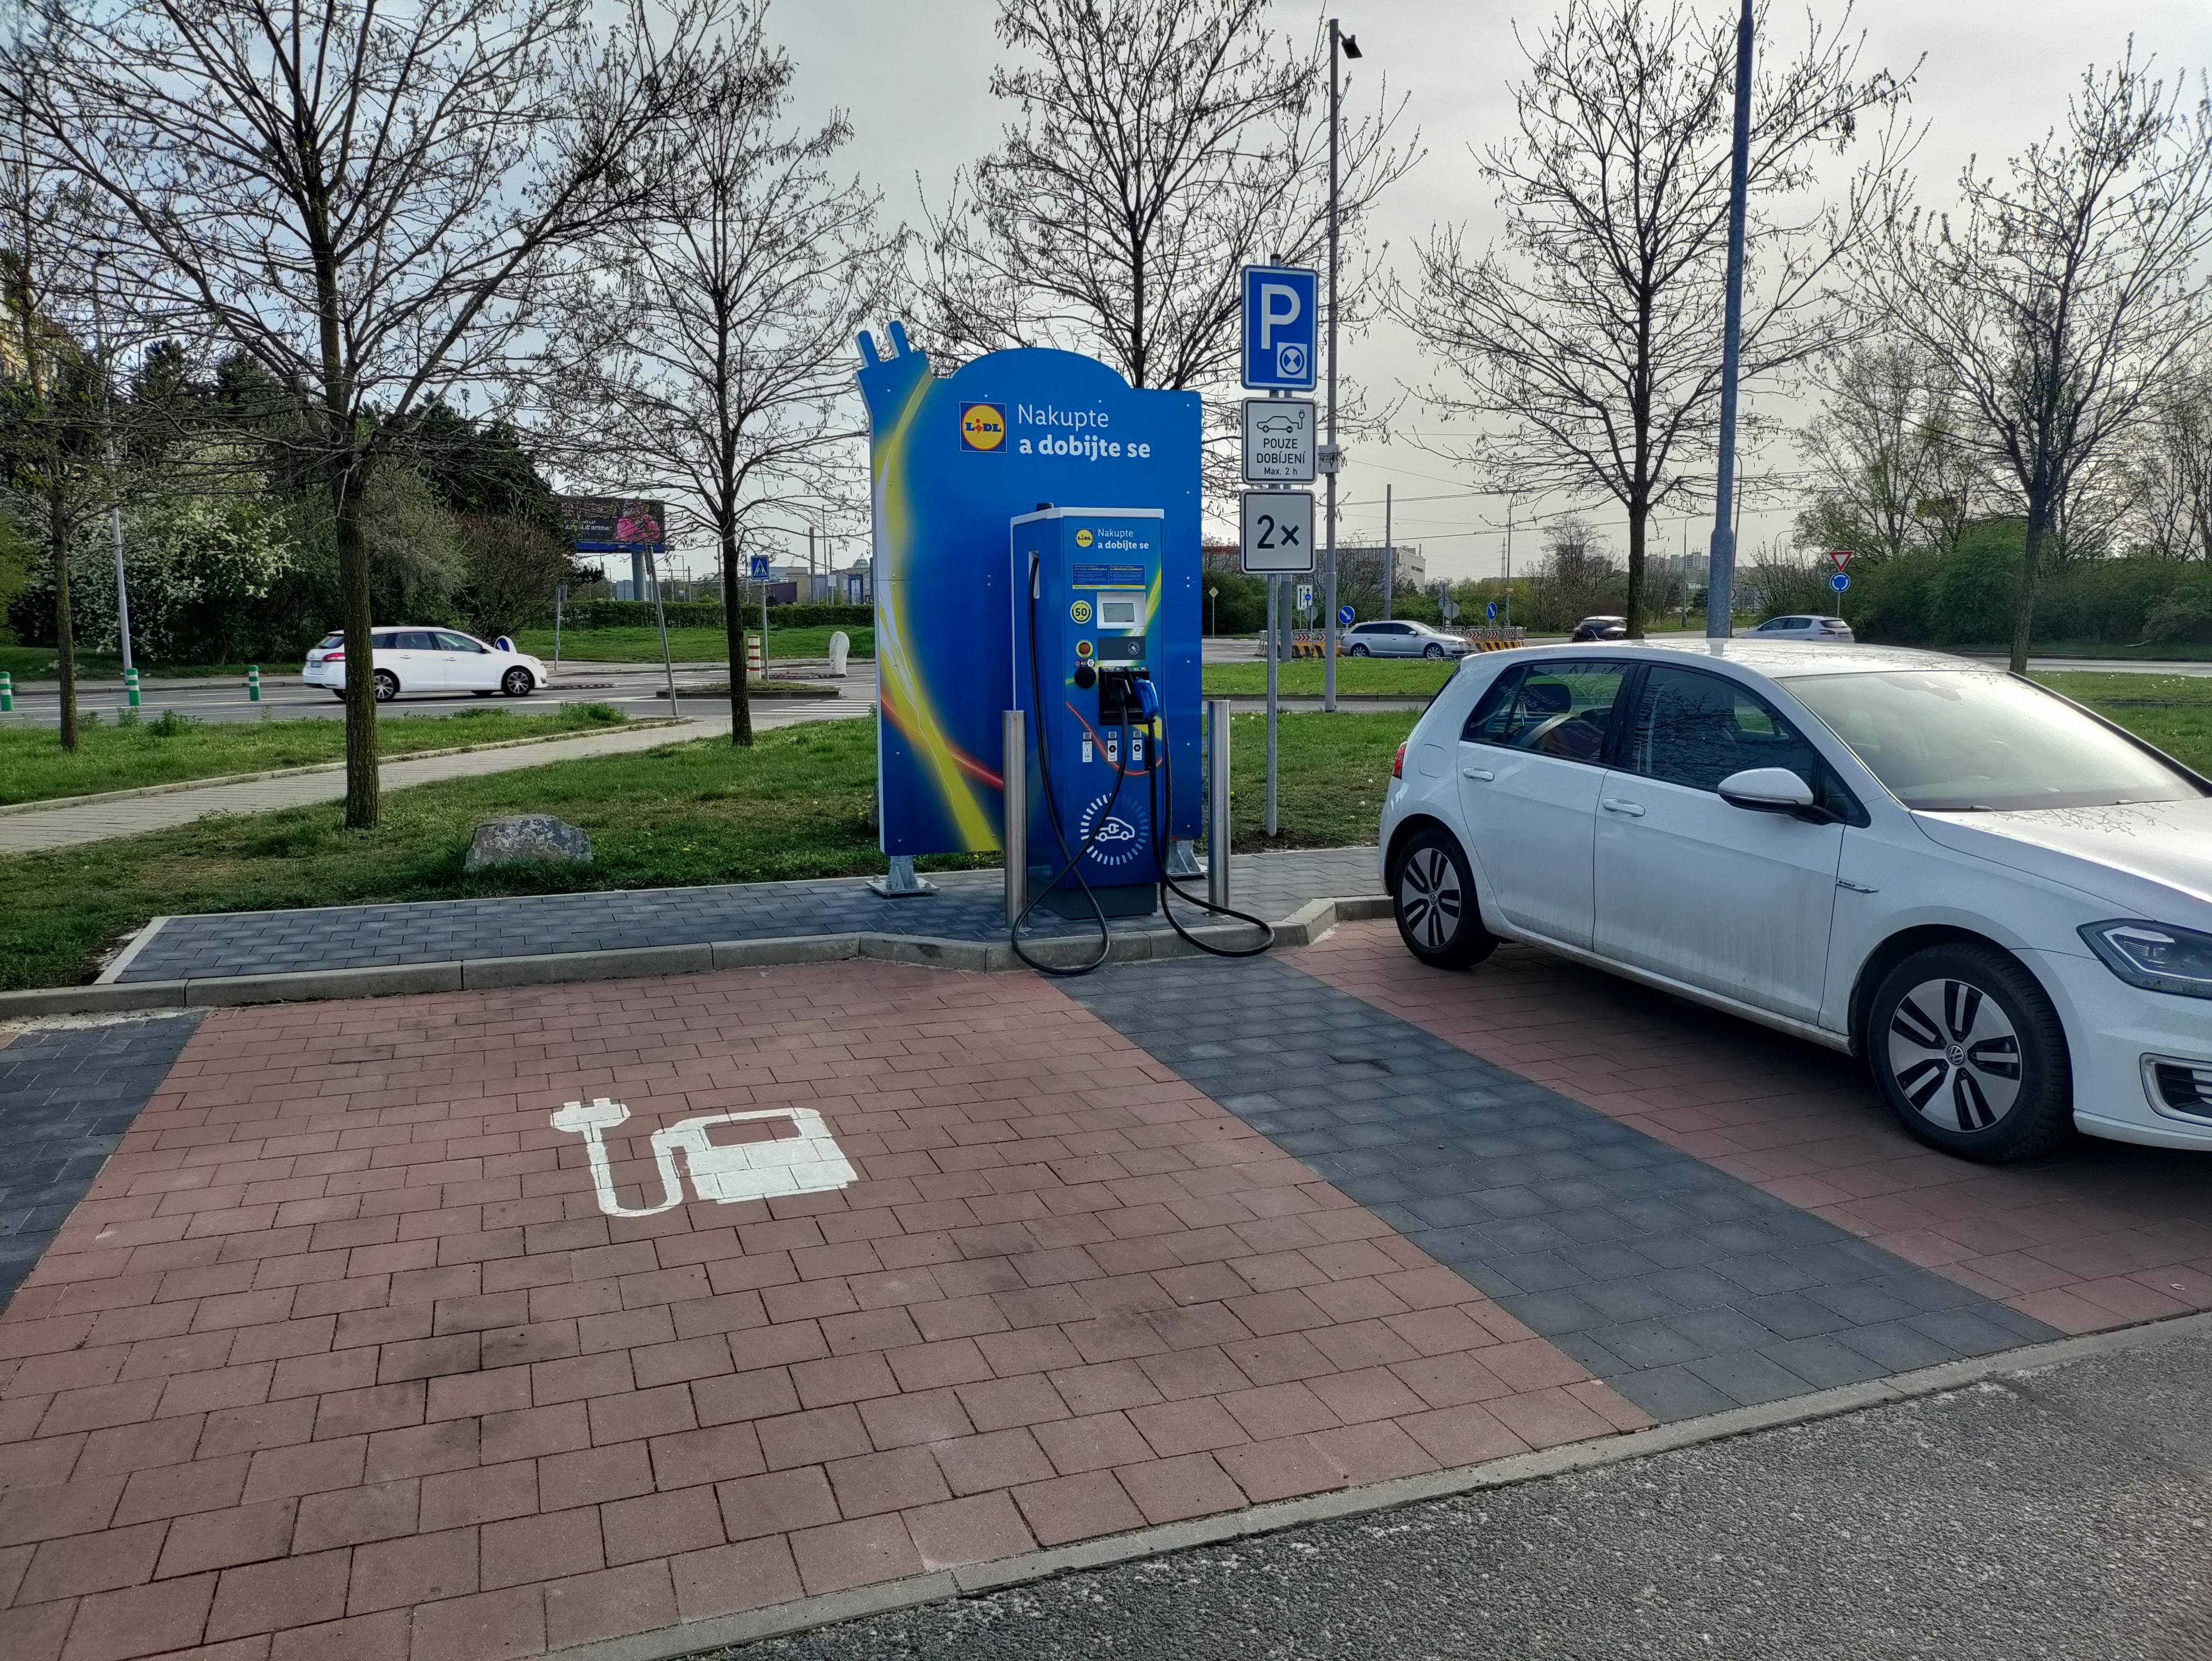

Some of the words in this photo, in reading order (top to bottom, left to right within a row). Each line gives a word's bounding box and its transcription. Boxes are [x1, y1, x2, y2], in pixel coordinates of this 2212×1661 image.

[1261, 283, 1301, 350] P
[1018, 404, 1109, 431] Nakupte
[1019, 439, 1032, 455] a
[1038, 434, 1121, 461] dobijte
[1126, 442, 1151, 458] se
[1263, 438, 1298, 449] POUZE
[1256, 451, 1306, 464] DOBÍJENÍ
[1264, 467, 1282, 475] Max.
[1293, 467, 1298, 475] h
[1098, 528, 1134, 539] Nakupte
[1105, 540, 1137, 550] dobijte
[1075, 608, 1087, 617] 50
